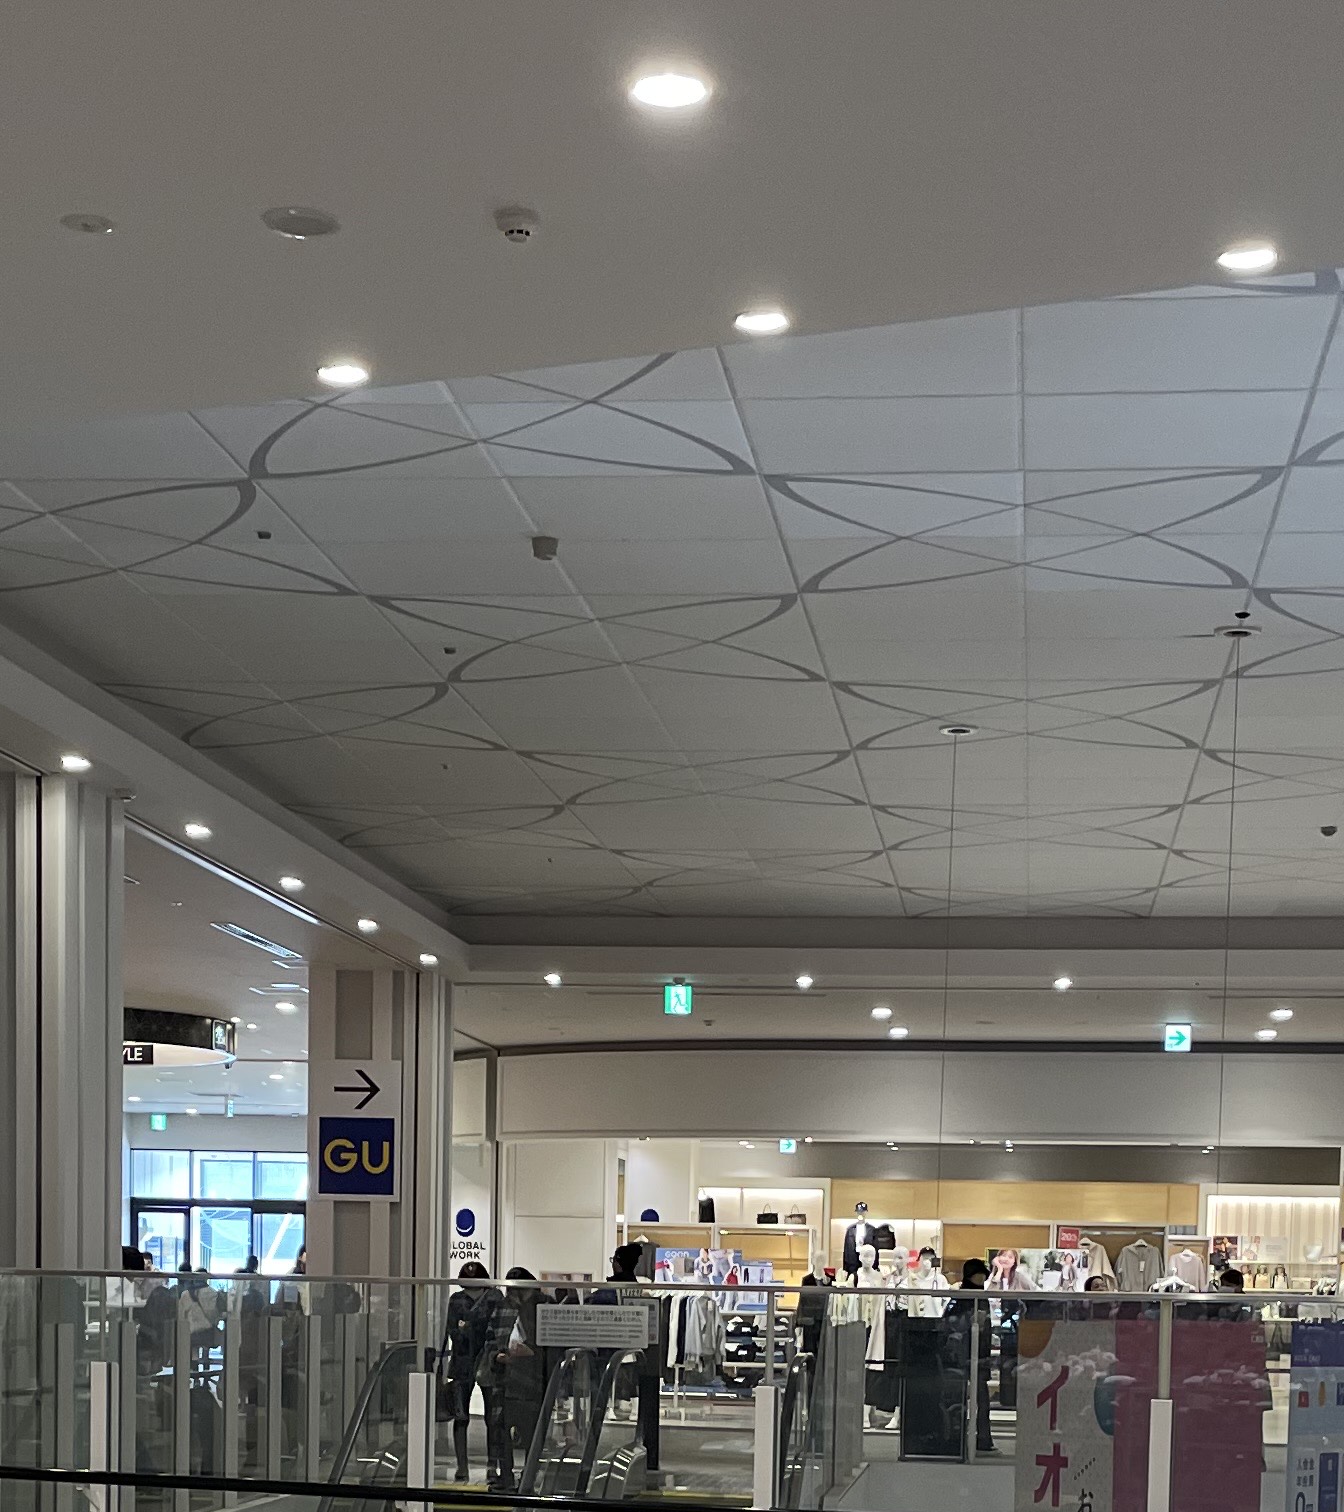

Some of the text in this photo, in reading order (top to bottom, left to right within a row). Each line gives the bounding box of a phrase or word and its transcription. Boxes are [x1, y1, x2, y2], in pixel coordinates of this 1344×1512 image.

[324, 1138, 389, 1174] GU
[452, 1241, 486, 1250] LOBAL
[450, 1251, 481, 1260] WORK
